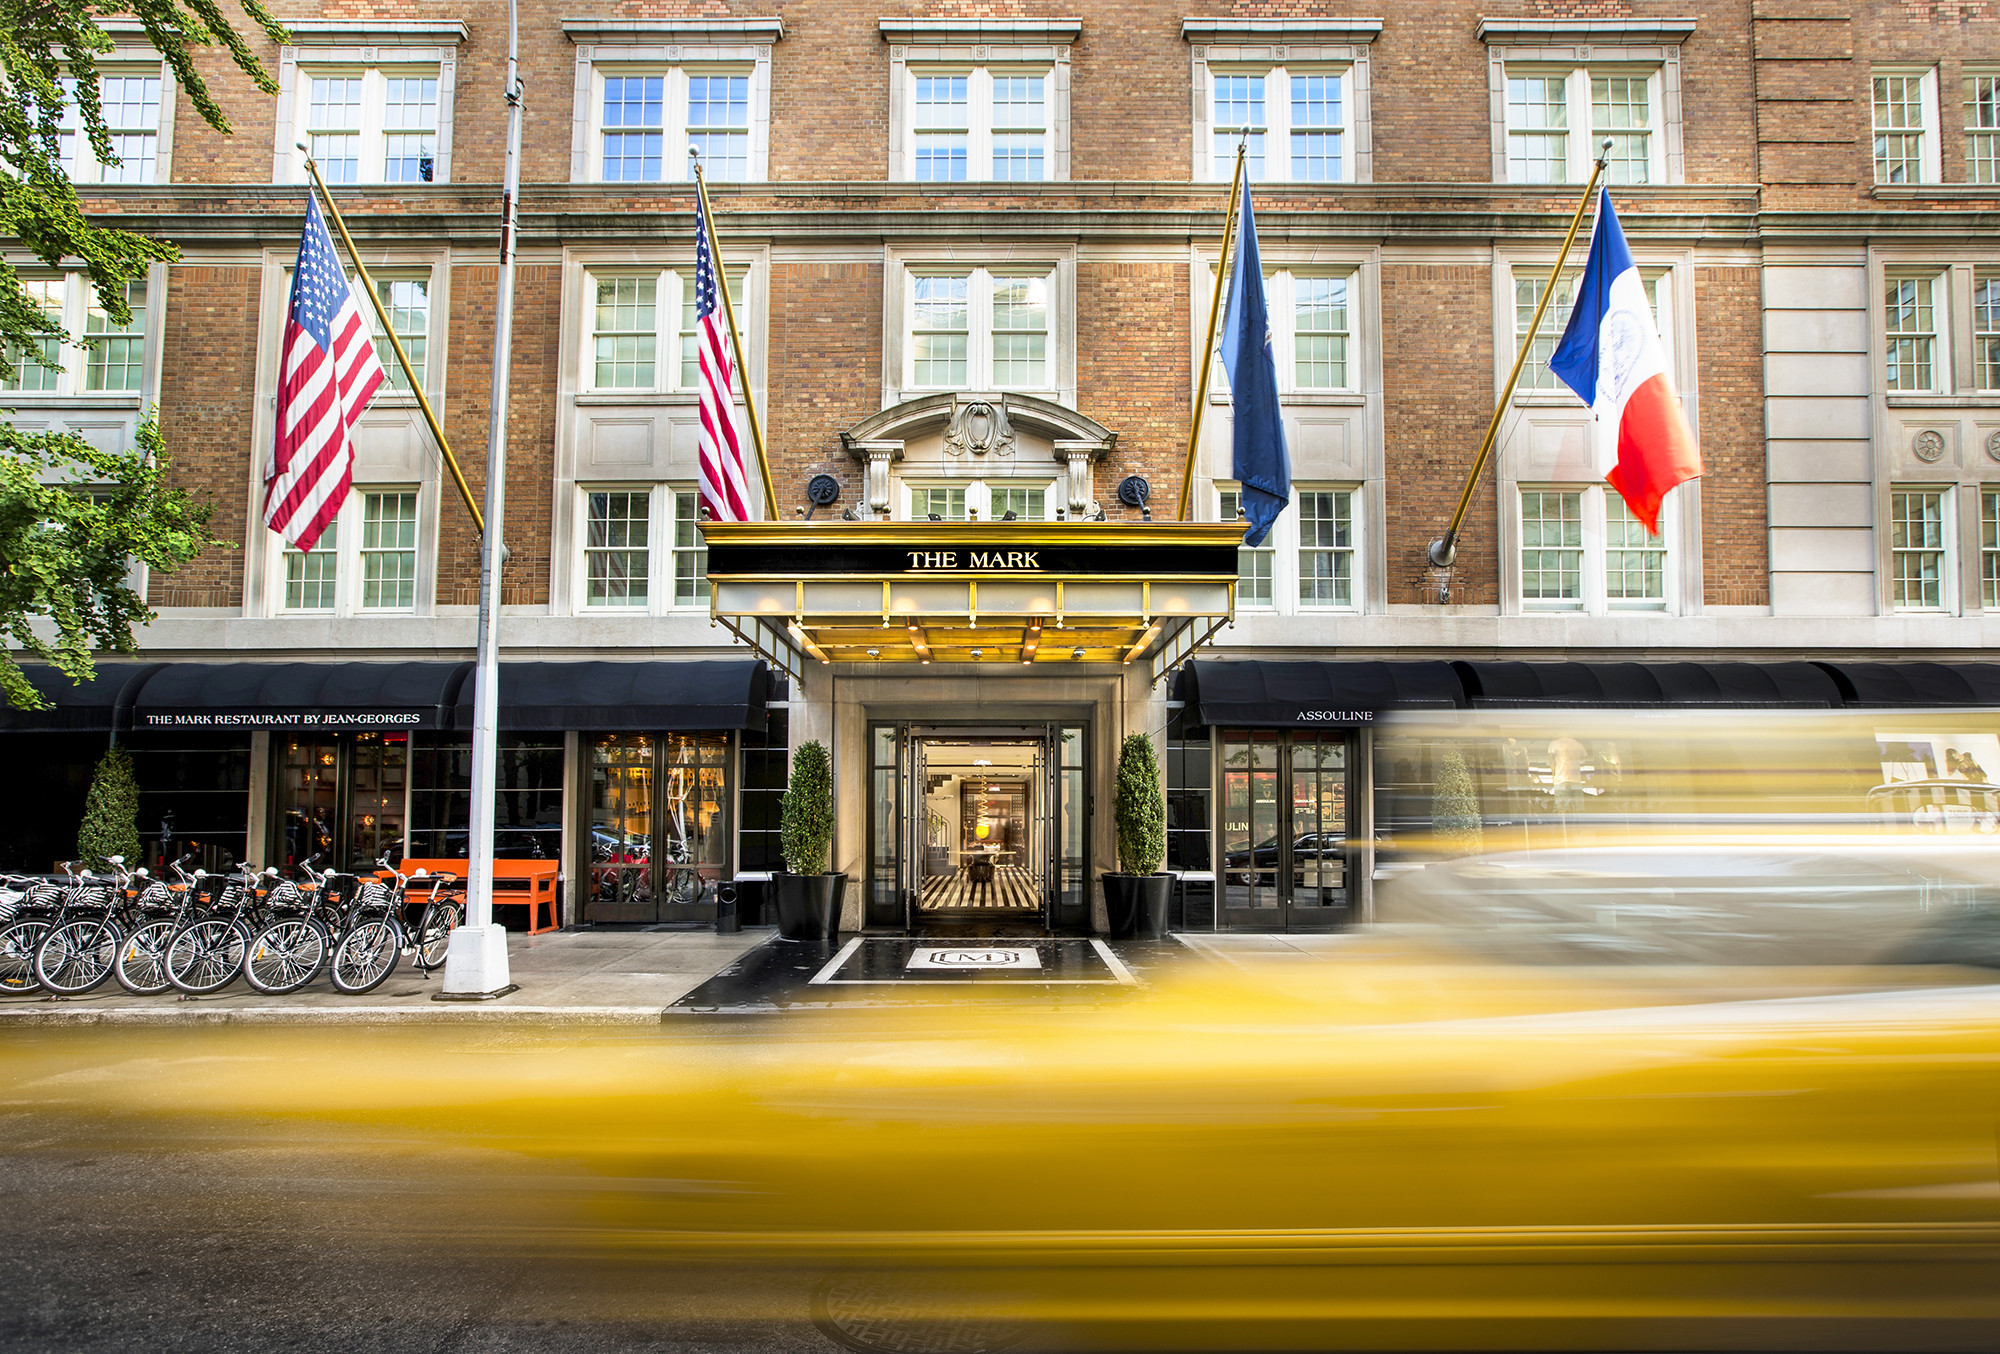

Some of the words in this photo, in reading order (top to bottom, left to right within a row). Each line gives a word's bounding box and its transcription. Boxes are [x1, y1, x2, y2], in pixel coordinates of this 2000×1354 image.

[906, 551, 958, 568] THE
[969, 551, 1040, 568] MARK
[147, 714, 173, 725] THE
[175, 714, 212, 725] MARK
[214, 714, 301, 725] RESTAURANT
[303, 714, 321, 725] BY
[322, 713, 421, 724] JEAN-GEORGES
[1296, 710, 1374, 721] ASSOULINE
